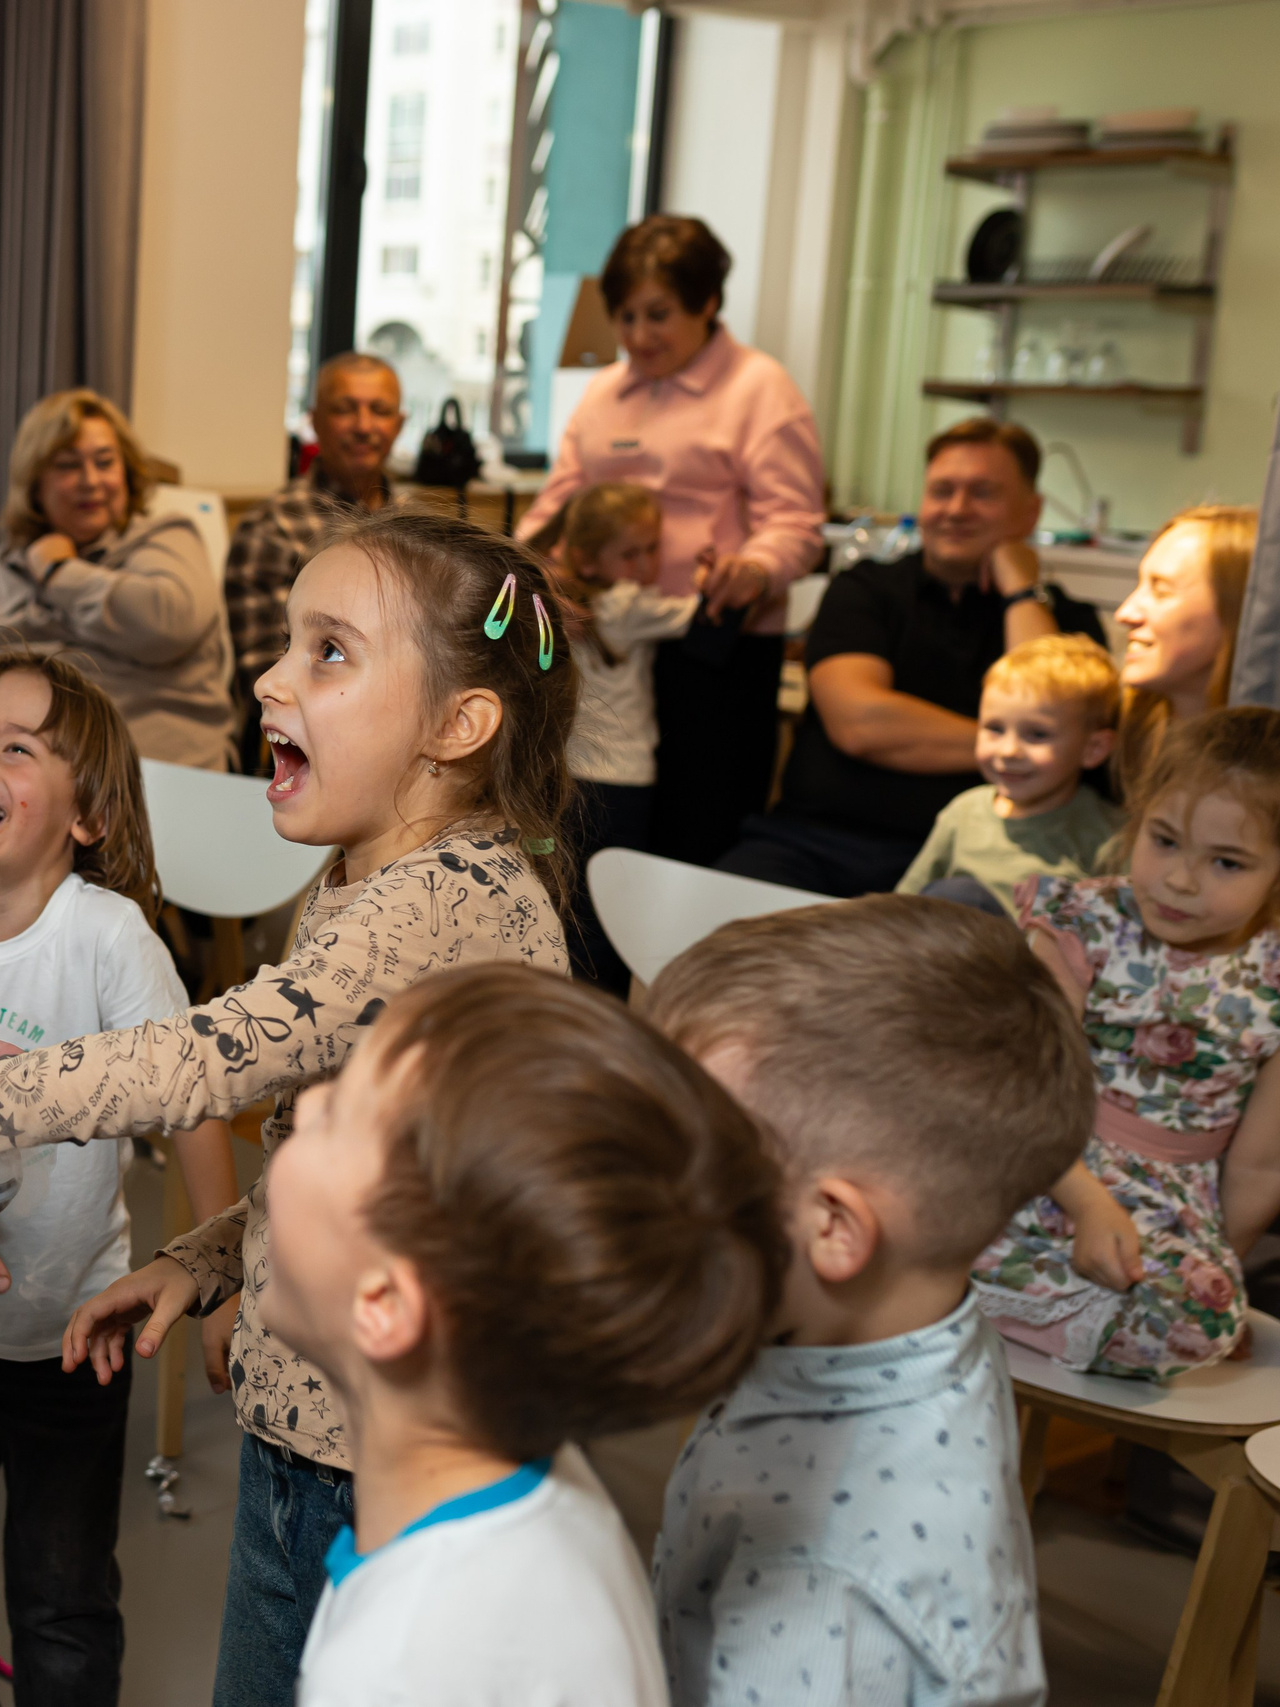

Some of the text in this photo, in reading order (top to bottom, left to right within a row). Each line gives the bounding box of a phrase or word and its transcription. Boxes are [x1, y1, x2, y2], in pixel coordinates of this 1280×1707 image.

[331, 961, 358, 990] ME
[88, 1071, 111, 1107] ALWAYS
[39, 1099, 65, 1127] ME
